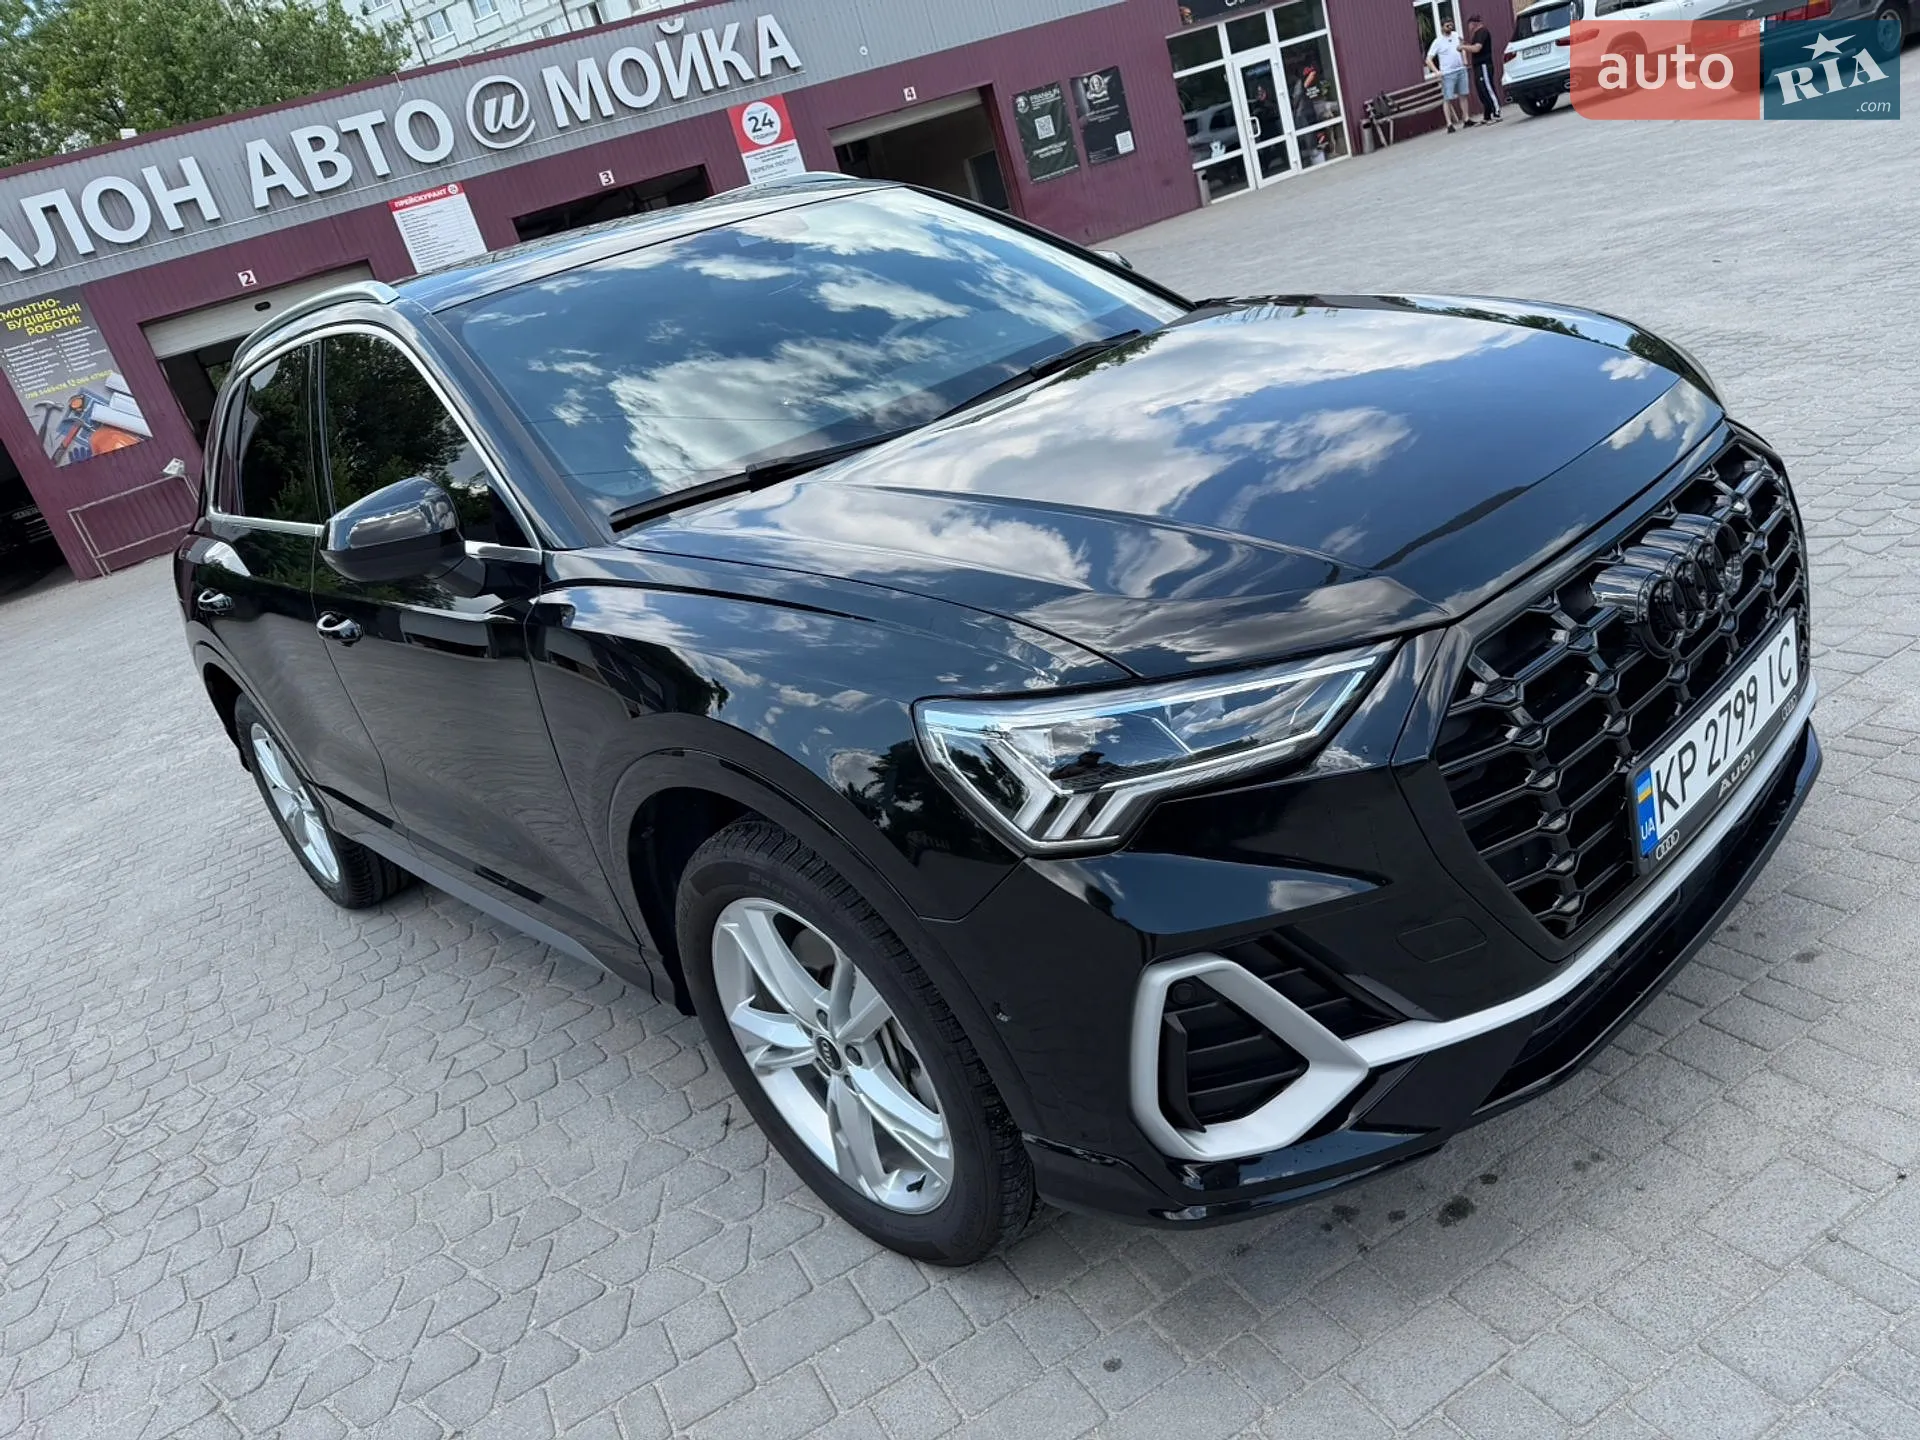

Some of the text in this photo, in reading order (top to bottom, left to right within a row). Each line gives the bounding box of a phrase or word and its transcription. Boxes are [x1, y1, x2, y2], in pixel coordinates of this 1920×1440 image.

[906, 88, 914, 98] 4
[245, 99, 455, 209] АВТО
[541, 14, 802, 129] МОЙКА
[748, 112, 774, 133] 24
[602, 172, 611, 184] 3
[241, 272, 254, 285] 2
[6, 302, 82, 331] БУДІВЕЛЬНІ
[26, 314, 82, 337] РОБОТИ:
[1655, 636, 1792, 825] KP 2799 IC
[1641, 817, 1656, 841] UA
